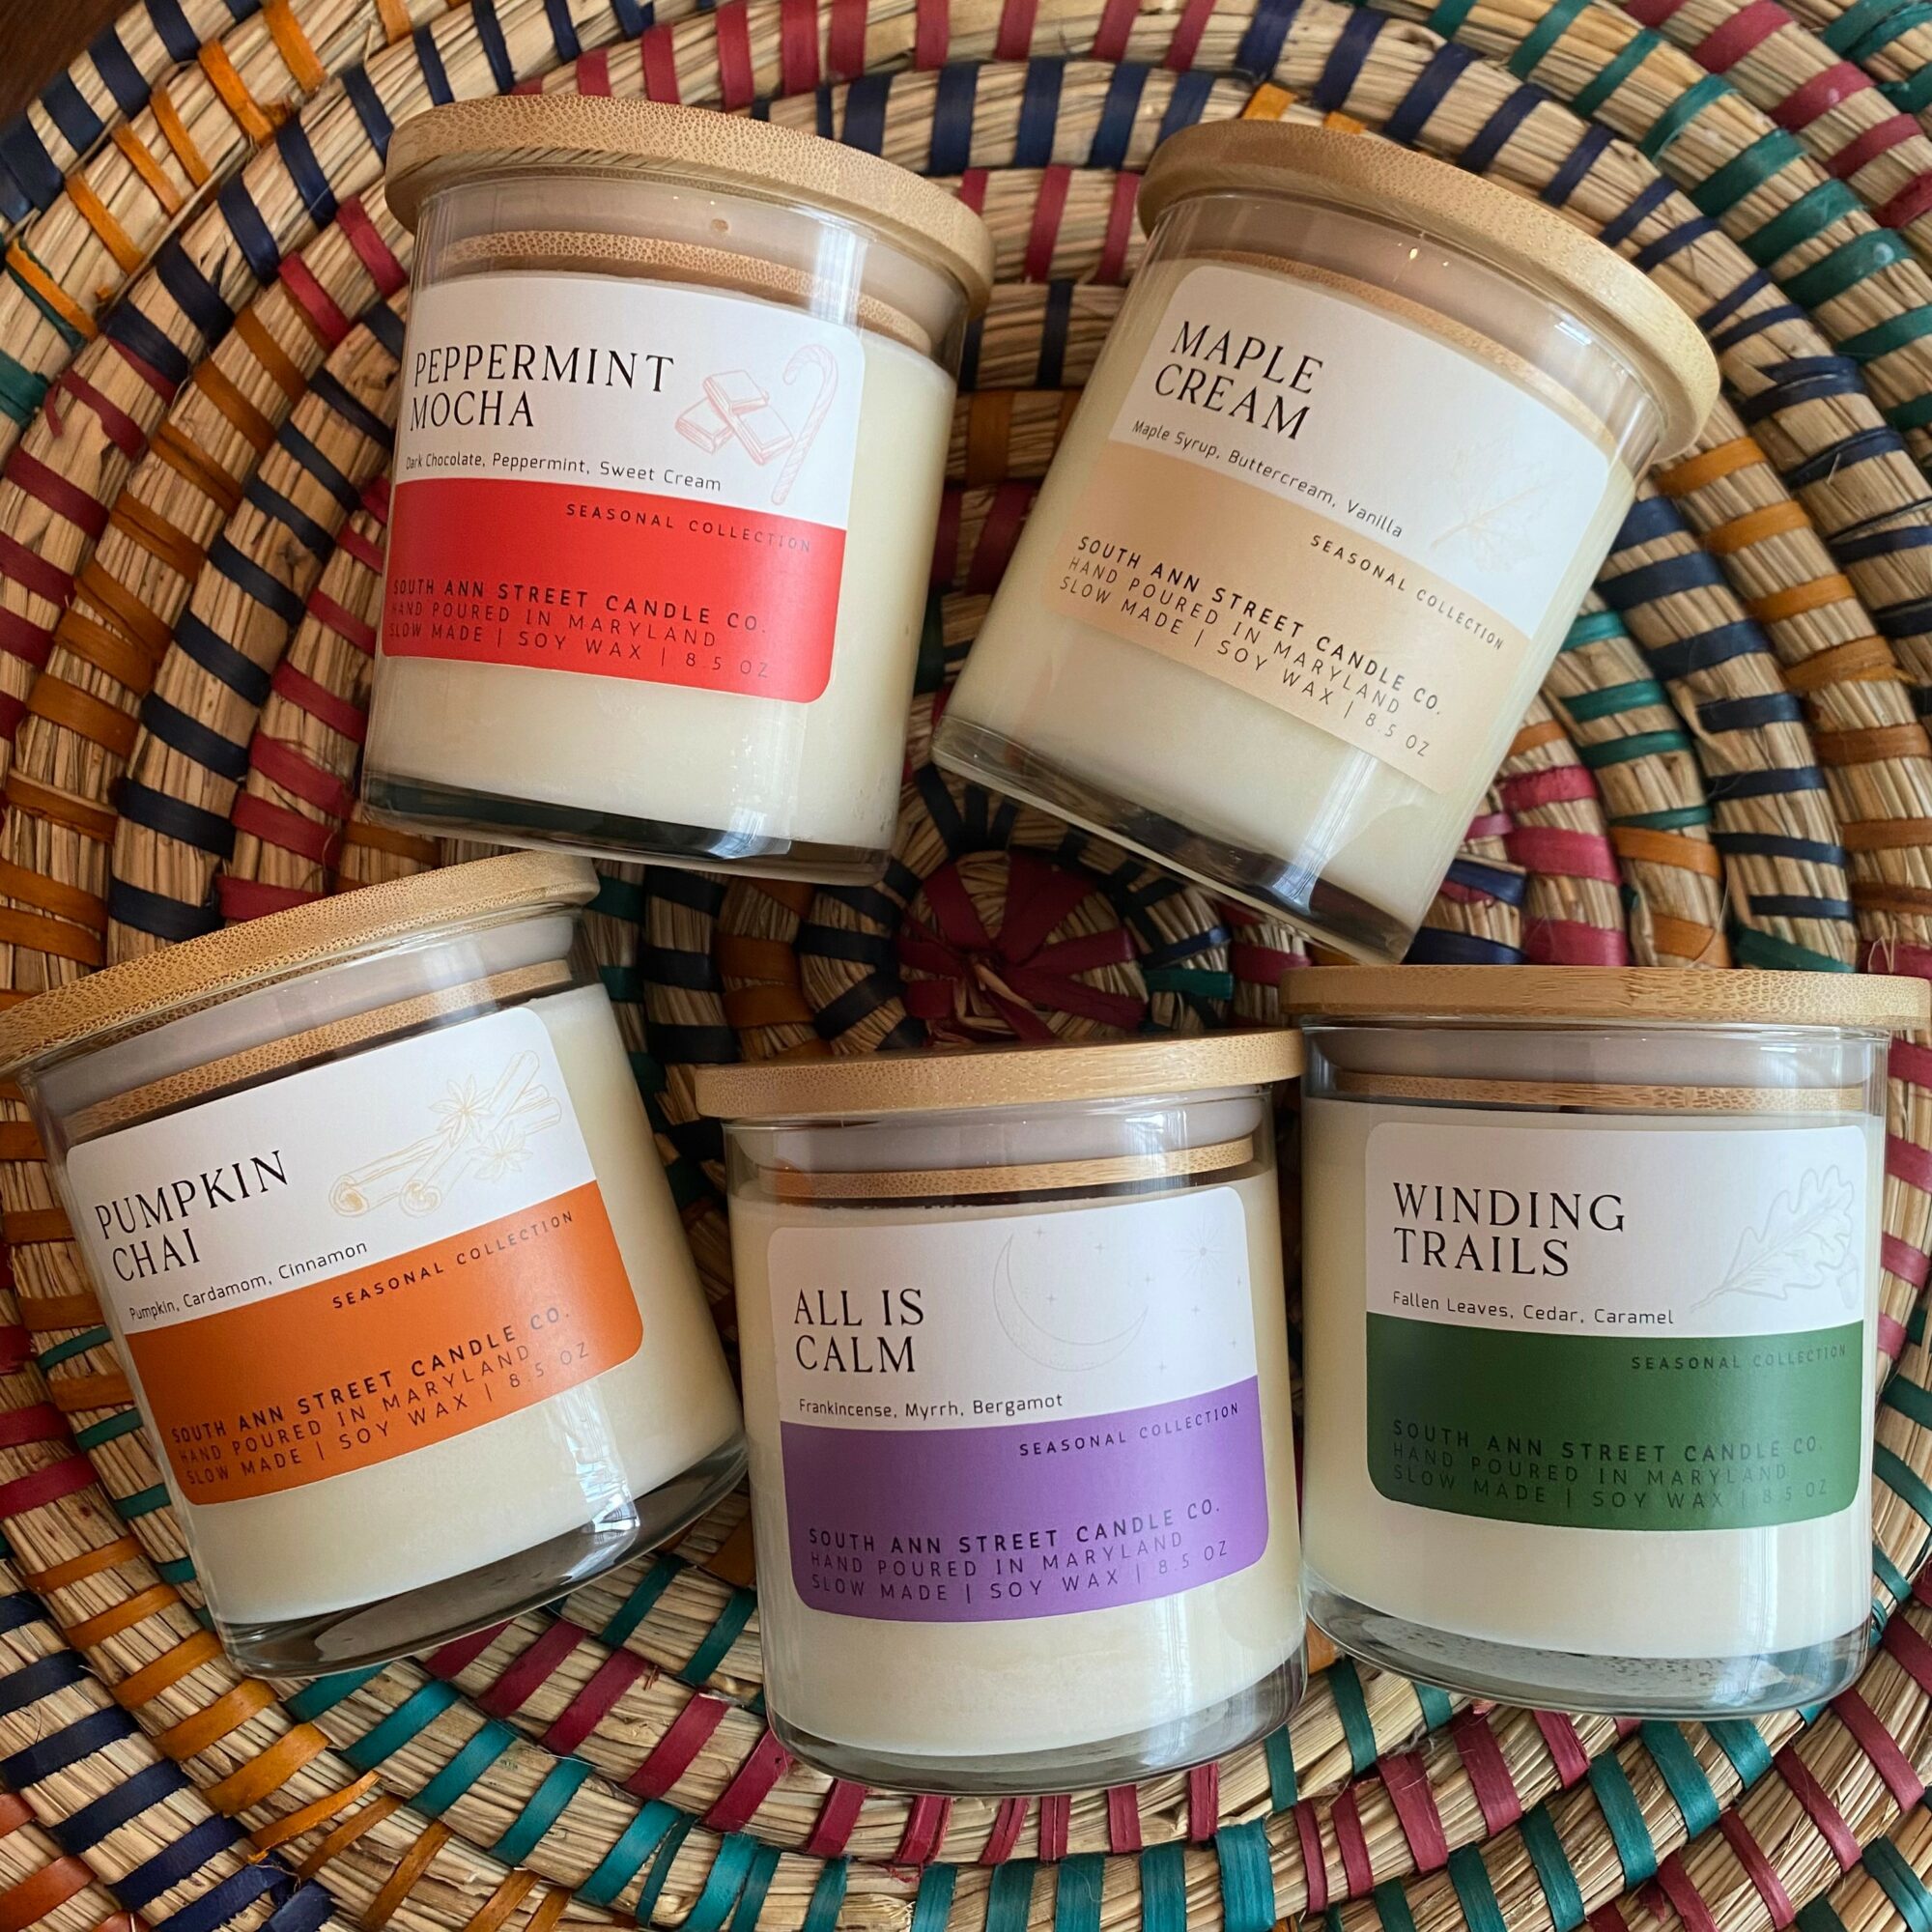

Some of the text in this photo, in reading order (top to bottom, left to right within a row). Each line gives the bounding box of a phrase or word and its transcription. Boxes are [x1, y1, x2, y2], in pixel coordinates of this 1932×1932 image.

[414, 344, 674, 393] PEPPERMINT
[1170, 321, 1323, 395] MAPLE
[410, 390, 534, 432] MOCHA
[1154, 363, 1310, 440] CREAM
[406, 452, 722, 492] Dark Chocolate, Peppermint, Sweet Cream
[1132, 419, 1403, 538] Maple Syrup, Buttercream, Vanilla
[566, 503, 810, 553] SEASONAL COLLECTION
[393, 579, 767, 633] SOUTH ANN STREET CANDLE CO.
[1310, 534, 1505, 650] SEASONAL COLLECTION
[389, 622, 420, 638] SLOW
[431, 624, 482, 641] MADE
[518, 633, 565, 649] SOY
[584, 639, 641, 661] WAX
[739, 660, 768, 678] OZ
[432, 604, 509, 622] POURED
[526, 610, 550, 627] IN
[569, 614, 717, 647] MARYLAND
[1068, 556, 1401, 714] HAND POURED IN MARYLAND
[1077, 536, 1440, 715] SOUTH ANN STREET CANDLE CO.
[1060, 576, 1113, 605] SLOW
[1121, 601, 1181, 635] MADE
[1217, 639, 1268, 672] SOY
[1281, 668, 1334, 705] WAX
[1406, 734, 1430, 757] OZ
[95, 1149, 289, 1239] PUMPKIN
[1392, 1181, 1626, 1232] WINDING
[112, 1228, 201, 1282] CHAI
[332, 1210, 574, 1310] SEASONAL COLLECTION
[1393, 1227, 1570, 1277] TRAILS
[129, 1242, 368, 1321] Pumpkin, Cardamom, Cinnamon
[793, 1288, 923, 1326] ALL IS
[1393, 1292, 1674, 1325] Fallen Leaves, Cedar, Caramel
[172, 1306, 569, 1444] SOUTH ANN STREET CANDLE CO.
[795, 1335, 916, 1374] CALM
[1632, 1345, 1847, 1371] SEASONAL COLLECTION
[180, 1345, 530, 1463] HAND POURED IN MARYLAND
[186, 1465, 230, 1485] SLOW
[242, 1452, 302, 1476] MADE
[339, 1421, 389, 1451] SOY
[410, 1394, 468, 1427] WAX
[559, 1342, 589, 1367] OZ
[799, 1394, 1064, 1421] Frankincense, Myrrh, Bergamot
[1019, 1402, 1239, 1457] SEASONAL COLLECTION
[1393, 1420, 1822, 1463] SOUTH ANN STREET CANDLE CO.
[1393, 1442, 1787, 1486] HAND POURED IN MARYLAND
[1393, 1464, 1456, 1489] SLOW
[1473, 1480, 1546, 1503] MADE
[1592, 1492, 1646, 1509] SOY
[1667, 1491, 1723, 1509] WAX
[1762, 1485, 1793, 1505] 85
[1805, 1479, 1829, 1498] OZ
[809, 1499, 1220, 1554] SOUTH ANN STREET CANDLE CO.
[811, 1531, 1182, 1577] HAND POURED IN MARYLAND
[812, 1573, 865, 1597] SLOW
[881, 1582, 949, 1601] MADE
[990, 1580, 1043, 1599] SOY
[1063, 1569, 1119, 1593] WAX
[1205, 1540, 1228, 1562] OZ
